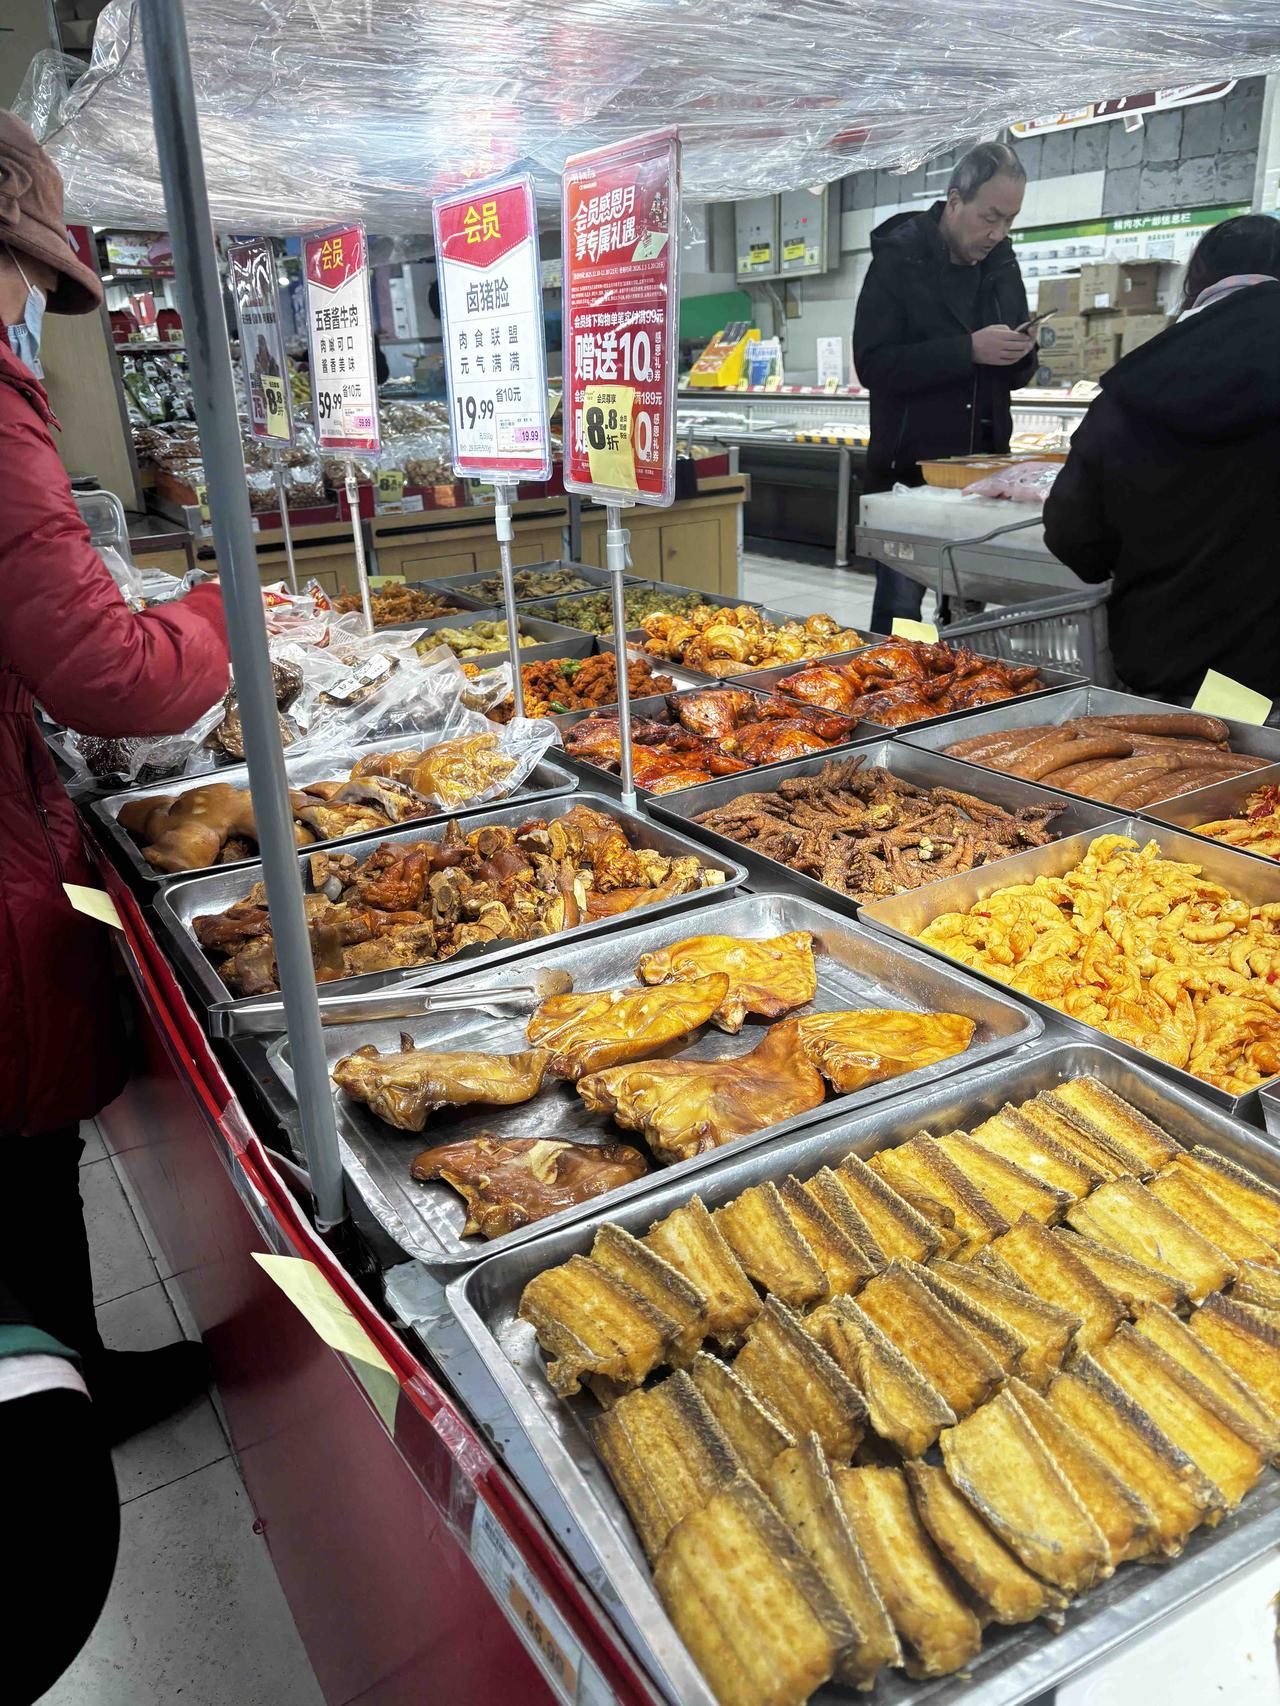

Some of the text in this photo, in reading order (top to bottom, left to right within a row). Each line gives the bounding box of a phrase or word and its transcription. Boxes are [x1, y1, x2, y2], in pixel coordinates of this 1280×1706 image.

[464, 201, 501, 244] 会员
[571, 185, 636, 232] 会员感恩月
[321, 238, 344, 270] 会员
[574, 216, 639, 263] 享专属礼遇
[466, 277, 510, 314] 卤猪脸
[315, 304, 358, 331] 五香酱牛肉
[654, 331, 662, 382] 感恩礼券
[318, 392, 342, 419] 59.99
[342, 384, 361, 398] 省10元
[496, 387, 521, 403] 省10元
[457, 396, 494, 429] 19.99
[521, 430, 539, 441] 19.99
